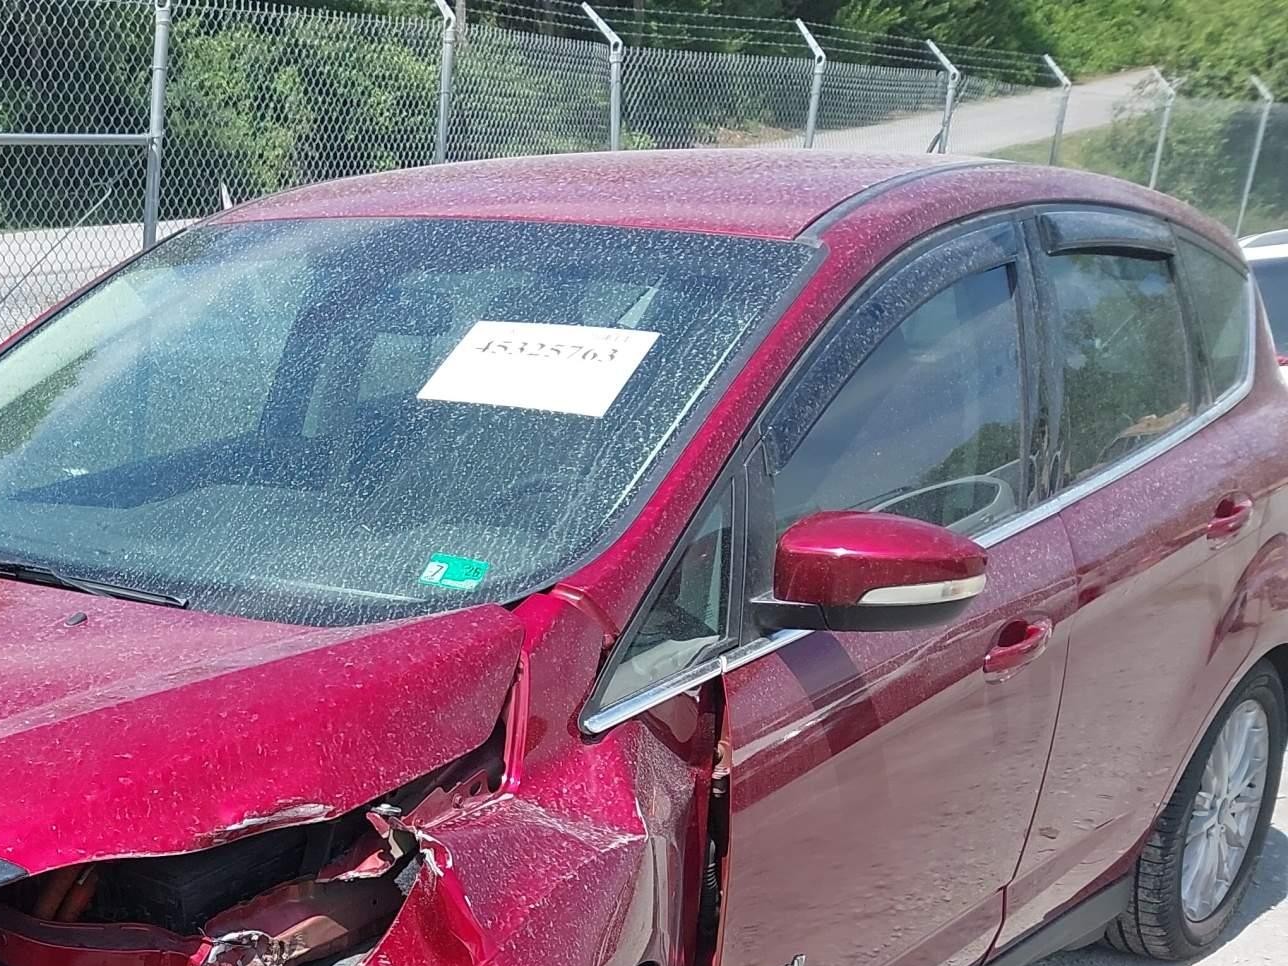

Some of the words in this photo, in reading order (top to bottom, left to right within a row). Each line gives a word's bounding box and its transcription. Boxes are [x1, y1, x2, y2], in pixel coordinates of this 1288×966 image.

[474, 340, 619, 362] 45325763
[431, 564, 445, 577] 7
[463, 564, 482, 578] 26
